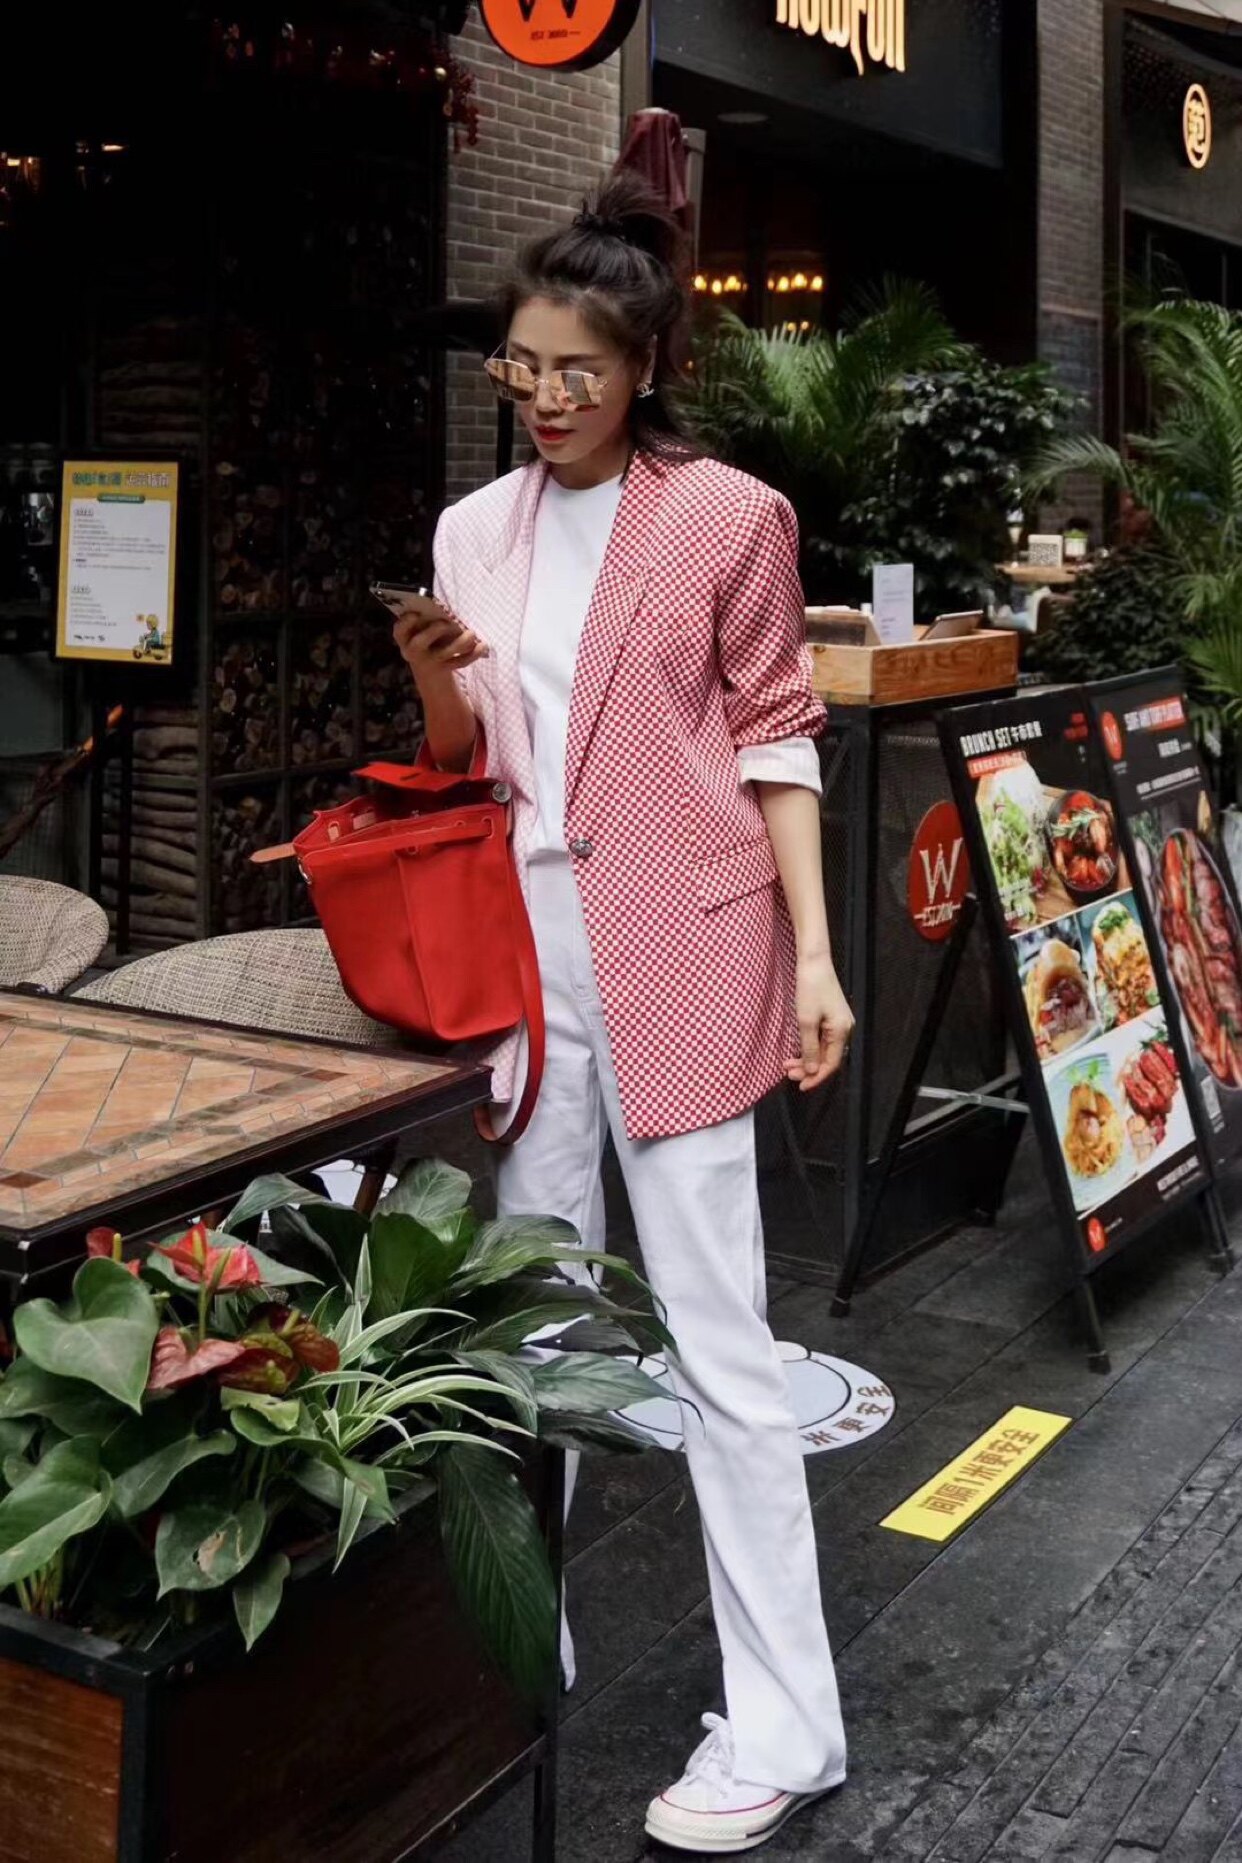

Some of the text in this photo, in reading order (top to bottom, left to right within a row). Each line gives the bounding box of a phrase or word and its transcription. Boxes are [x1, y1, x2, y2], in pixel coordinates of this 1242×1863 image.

[994, 726, 1013, 750] SET
[919, 837, 964, 905] W
[917, 1428, 1041, 1516] 间隔1米更安全
